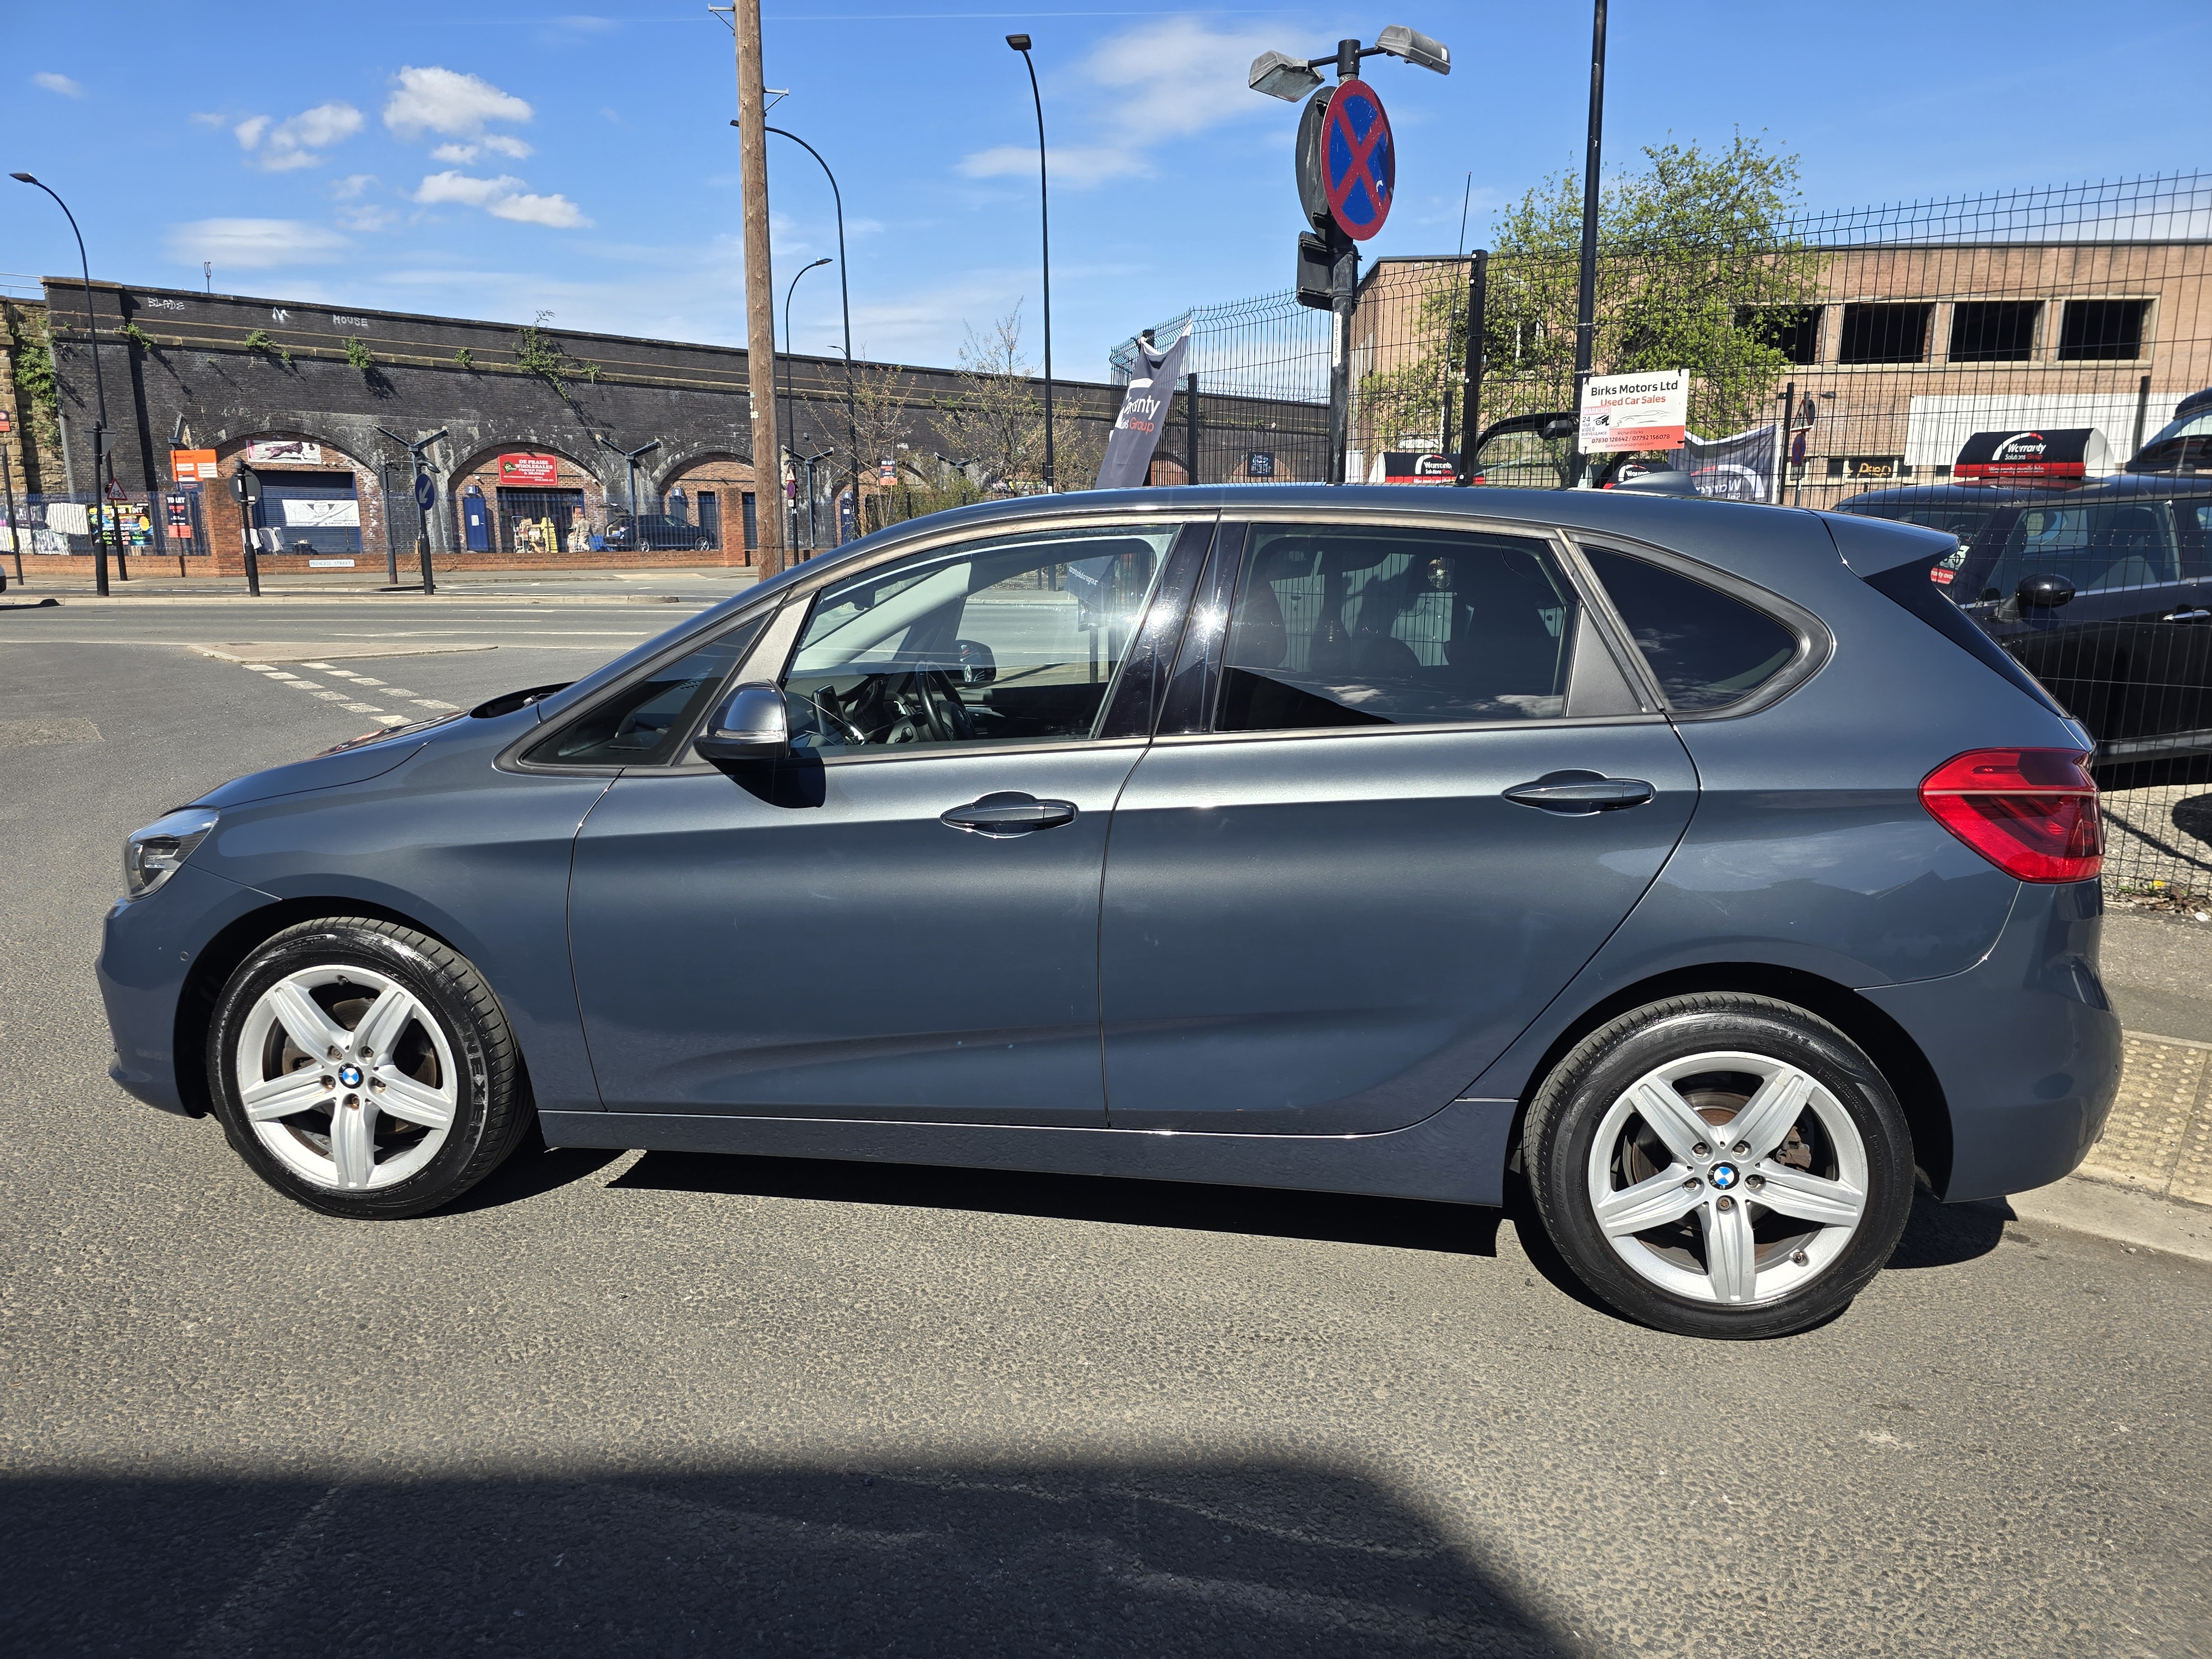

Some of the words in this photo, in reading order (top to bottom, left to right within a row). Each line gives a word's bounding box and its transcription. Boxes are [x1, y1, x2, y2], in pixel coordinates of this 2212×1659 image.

[333, 314, 369, 327] HOUSE
[1591, 387, 1617, 396] Birks
[1620, 383, 1657, 394] Motors
[1660, 380, 1678, 390] Ltd
[1601, 398, 1623, 406] Used
[1641, 395, 1666, 404] Sales
[1130, 416, 1154, 435] Group
[2007, 442, 2047, 454] Warranty
[464, 1031, 486, 1144] NEXEN
